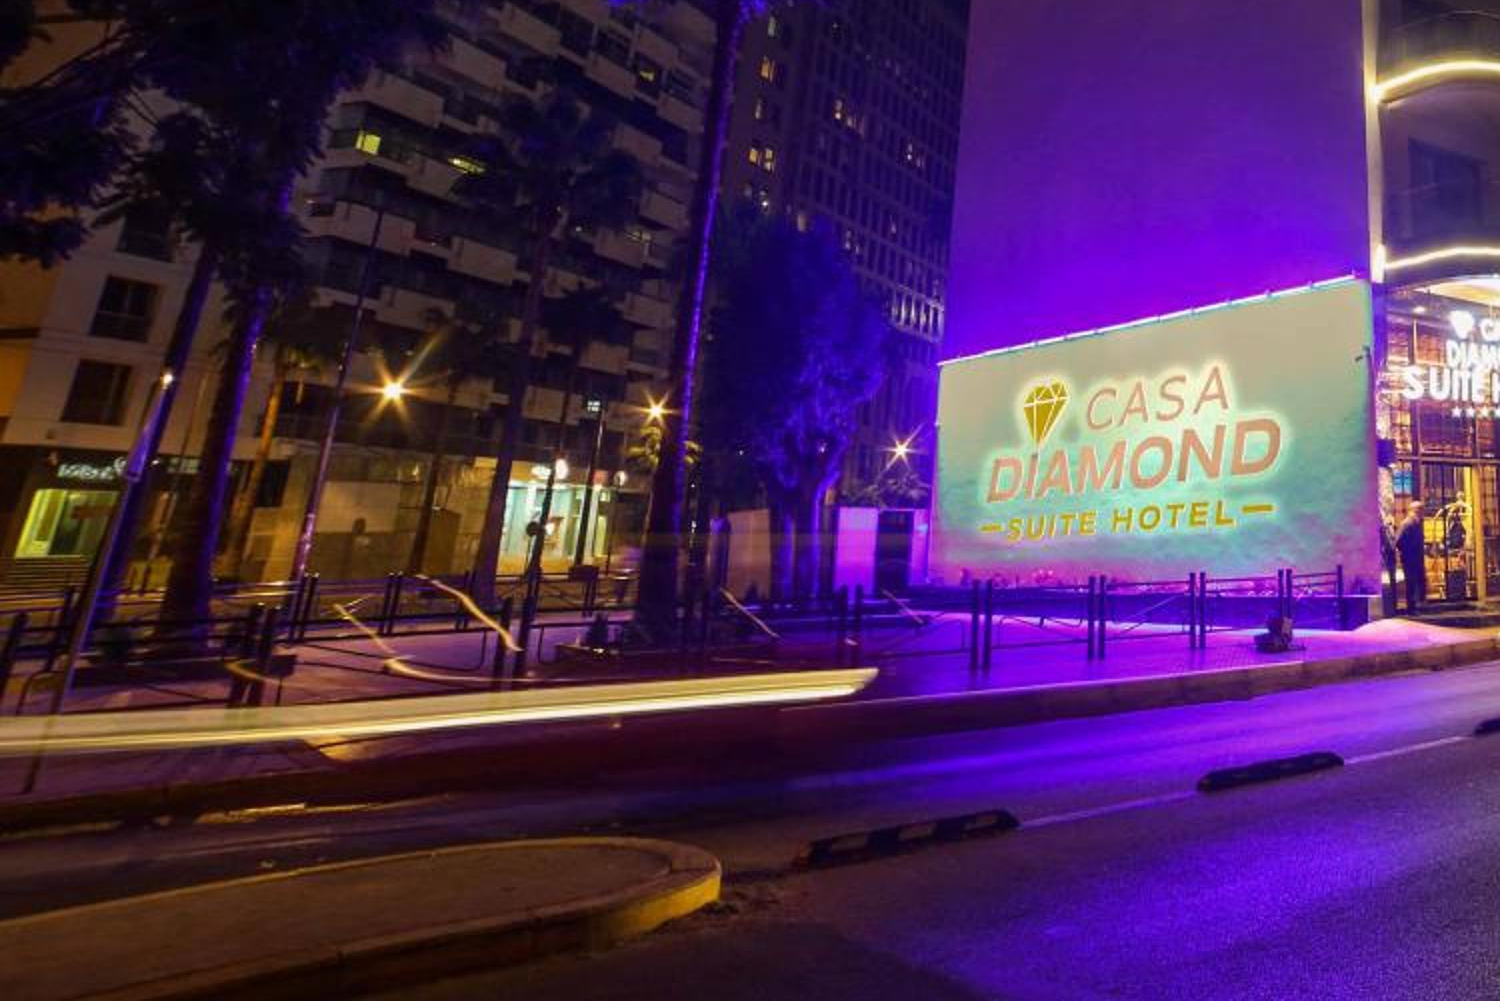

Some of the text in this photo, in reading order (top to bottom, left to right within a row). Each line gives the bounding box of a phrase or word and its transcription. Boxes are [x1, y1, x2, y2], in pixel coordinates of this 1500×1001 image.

[1086, 366, 1229, 430] CASA
[1402, 366, 1490, 403] SUITE
[986, 418, 1281, 503] DIAMOND
[1007, 500, 1234, 542] SUITE HOTEL
